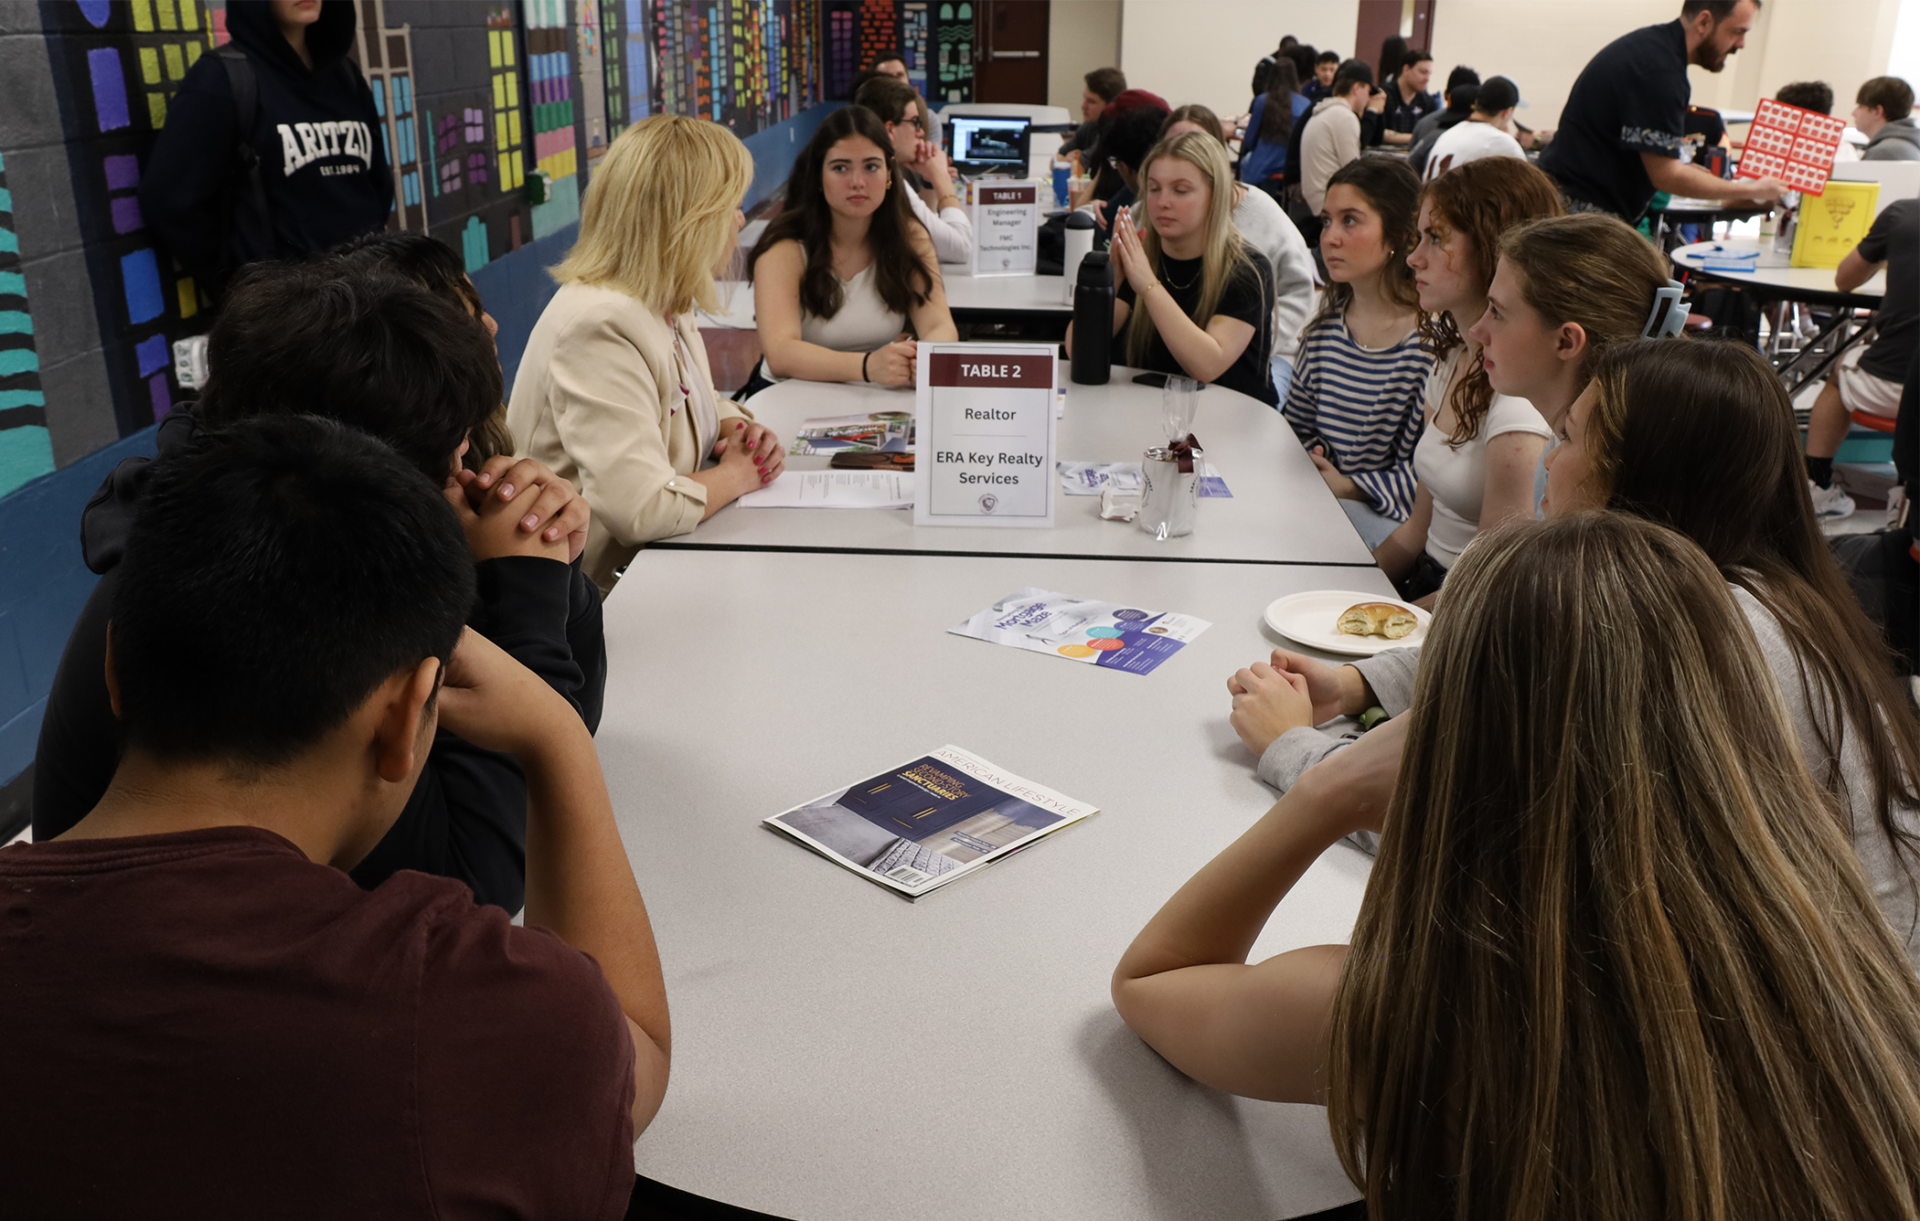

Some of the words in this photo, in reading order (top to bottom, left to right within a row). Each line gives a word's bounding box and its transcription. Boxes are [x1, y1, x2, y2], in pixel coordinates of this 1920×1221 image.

[993, 192, 1016, 200] TABLE
[987, 208, 1027, 216] Engineering
[992, 219, 1021, 227] Manager
[961, 364, 1009, 378] TABLE
[1012, 365, 1022, 378] 2
[965, 408, 1017, 421] Realtor
[936, 451, 965, 464] ERA
[968, 452, 995, 467] Key
[998, 453, 1043, 468] Realty
[959, 472, 1020, 485] Services
[994, 602, 1047, 630] Mortgage
[918, 763, 967, 789] REVAMPING
[936, 750, 1006, 786] AMERICAN
[1003, 782, 1082, 816] LIFESTYLE
[902, 770, 960, 801] SANCTUARIES
